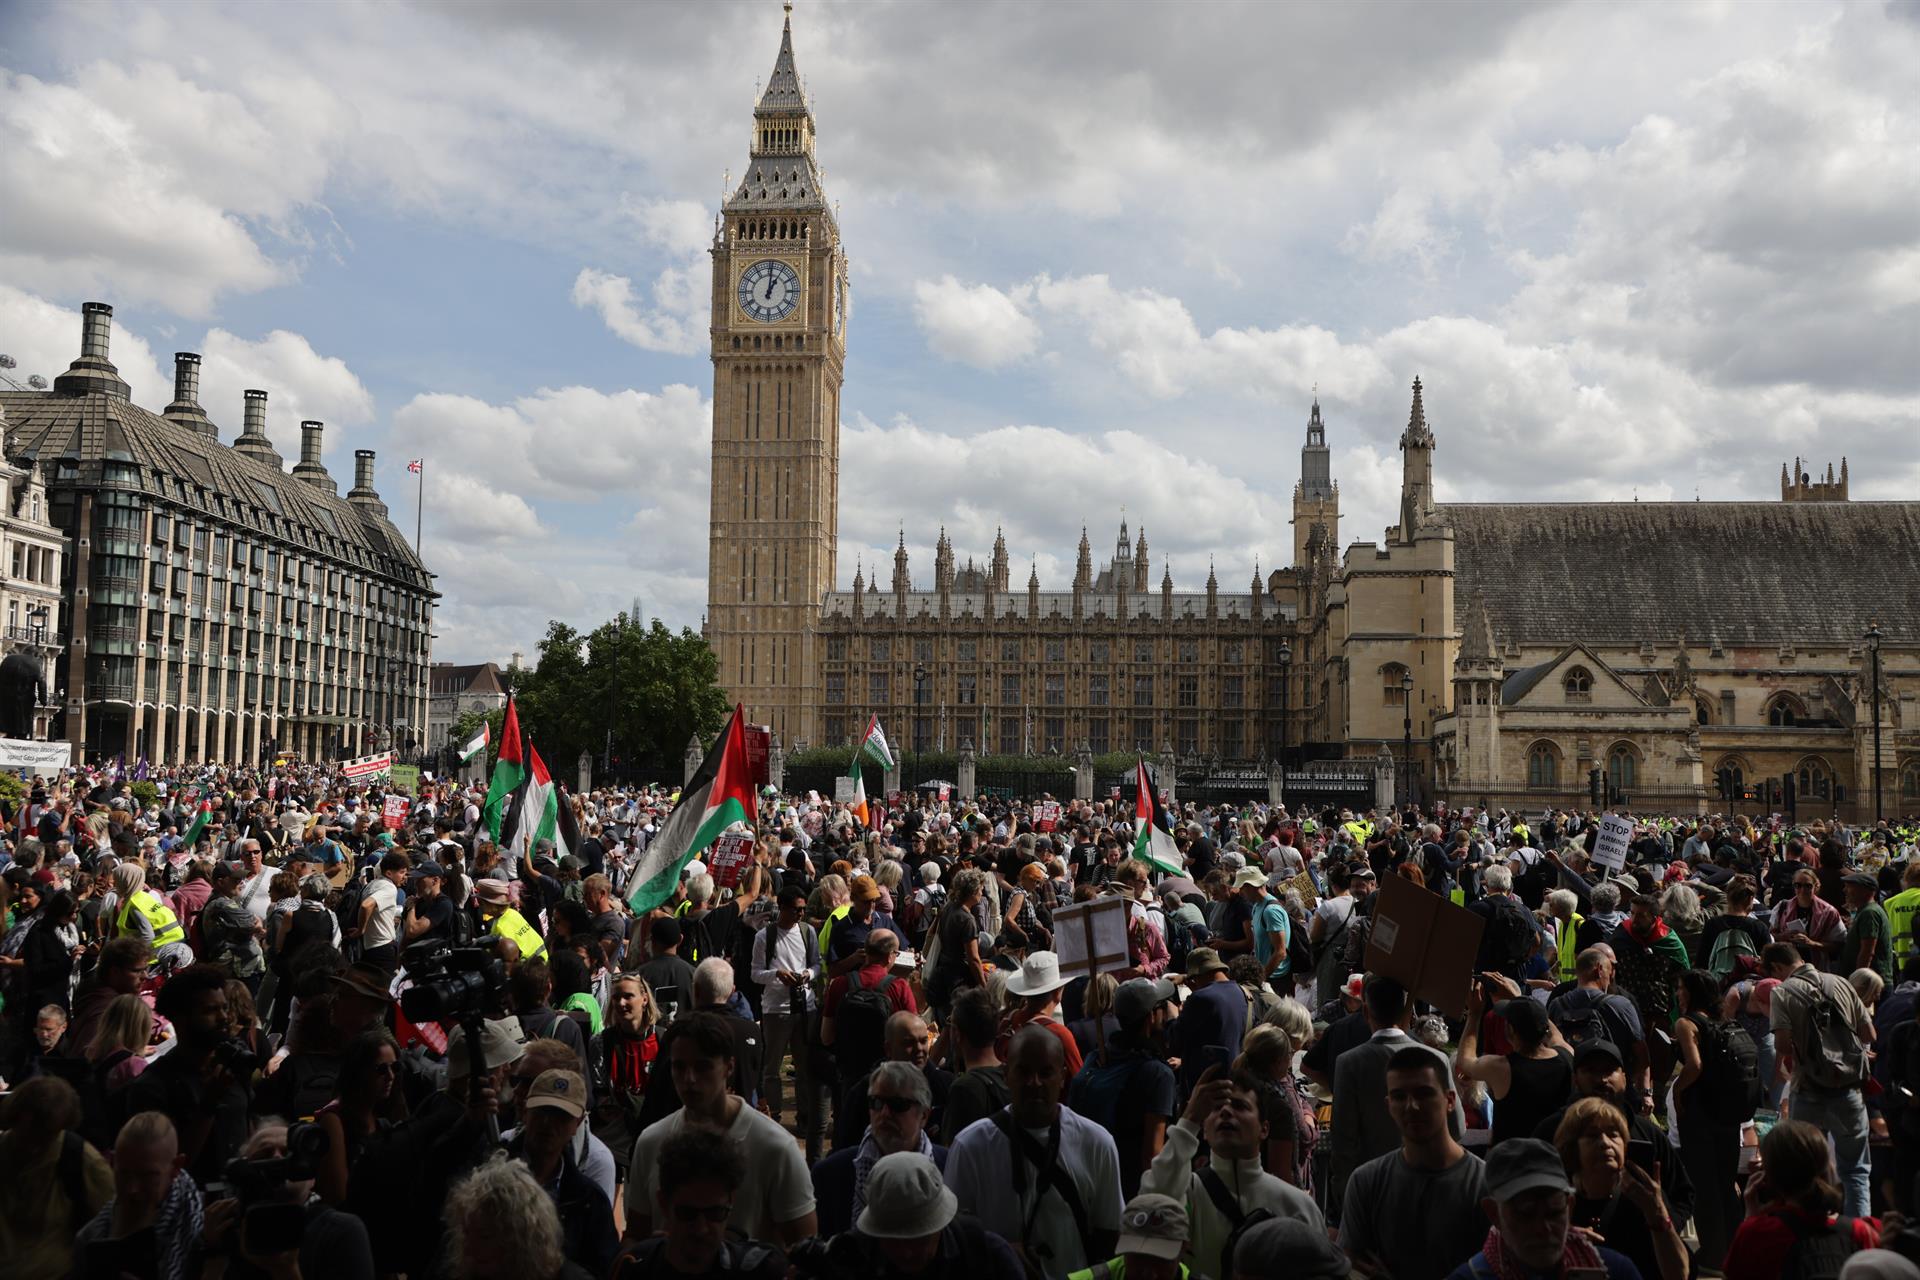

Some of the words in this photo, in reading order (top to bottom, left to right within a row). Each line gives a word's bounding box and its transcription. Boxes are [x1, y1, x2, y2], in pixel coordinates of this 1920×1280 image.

[1603, 822, 1629, 836] STOP
[1600, 834, 1626, 847] ARMING
[1598, 843, 1624, 856] ISRAEL!
